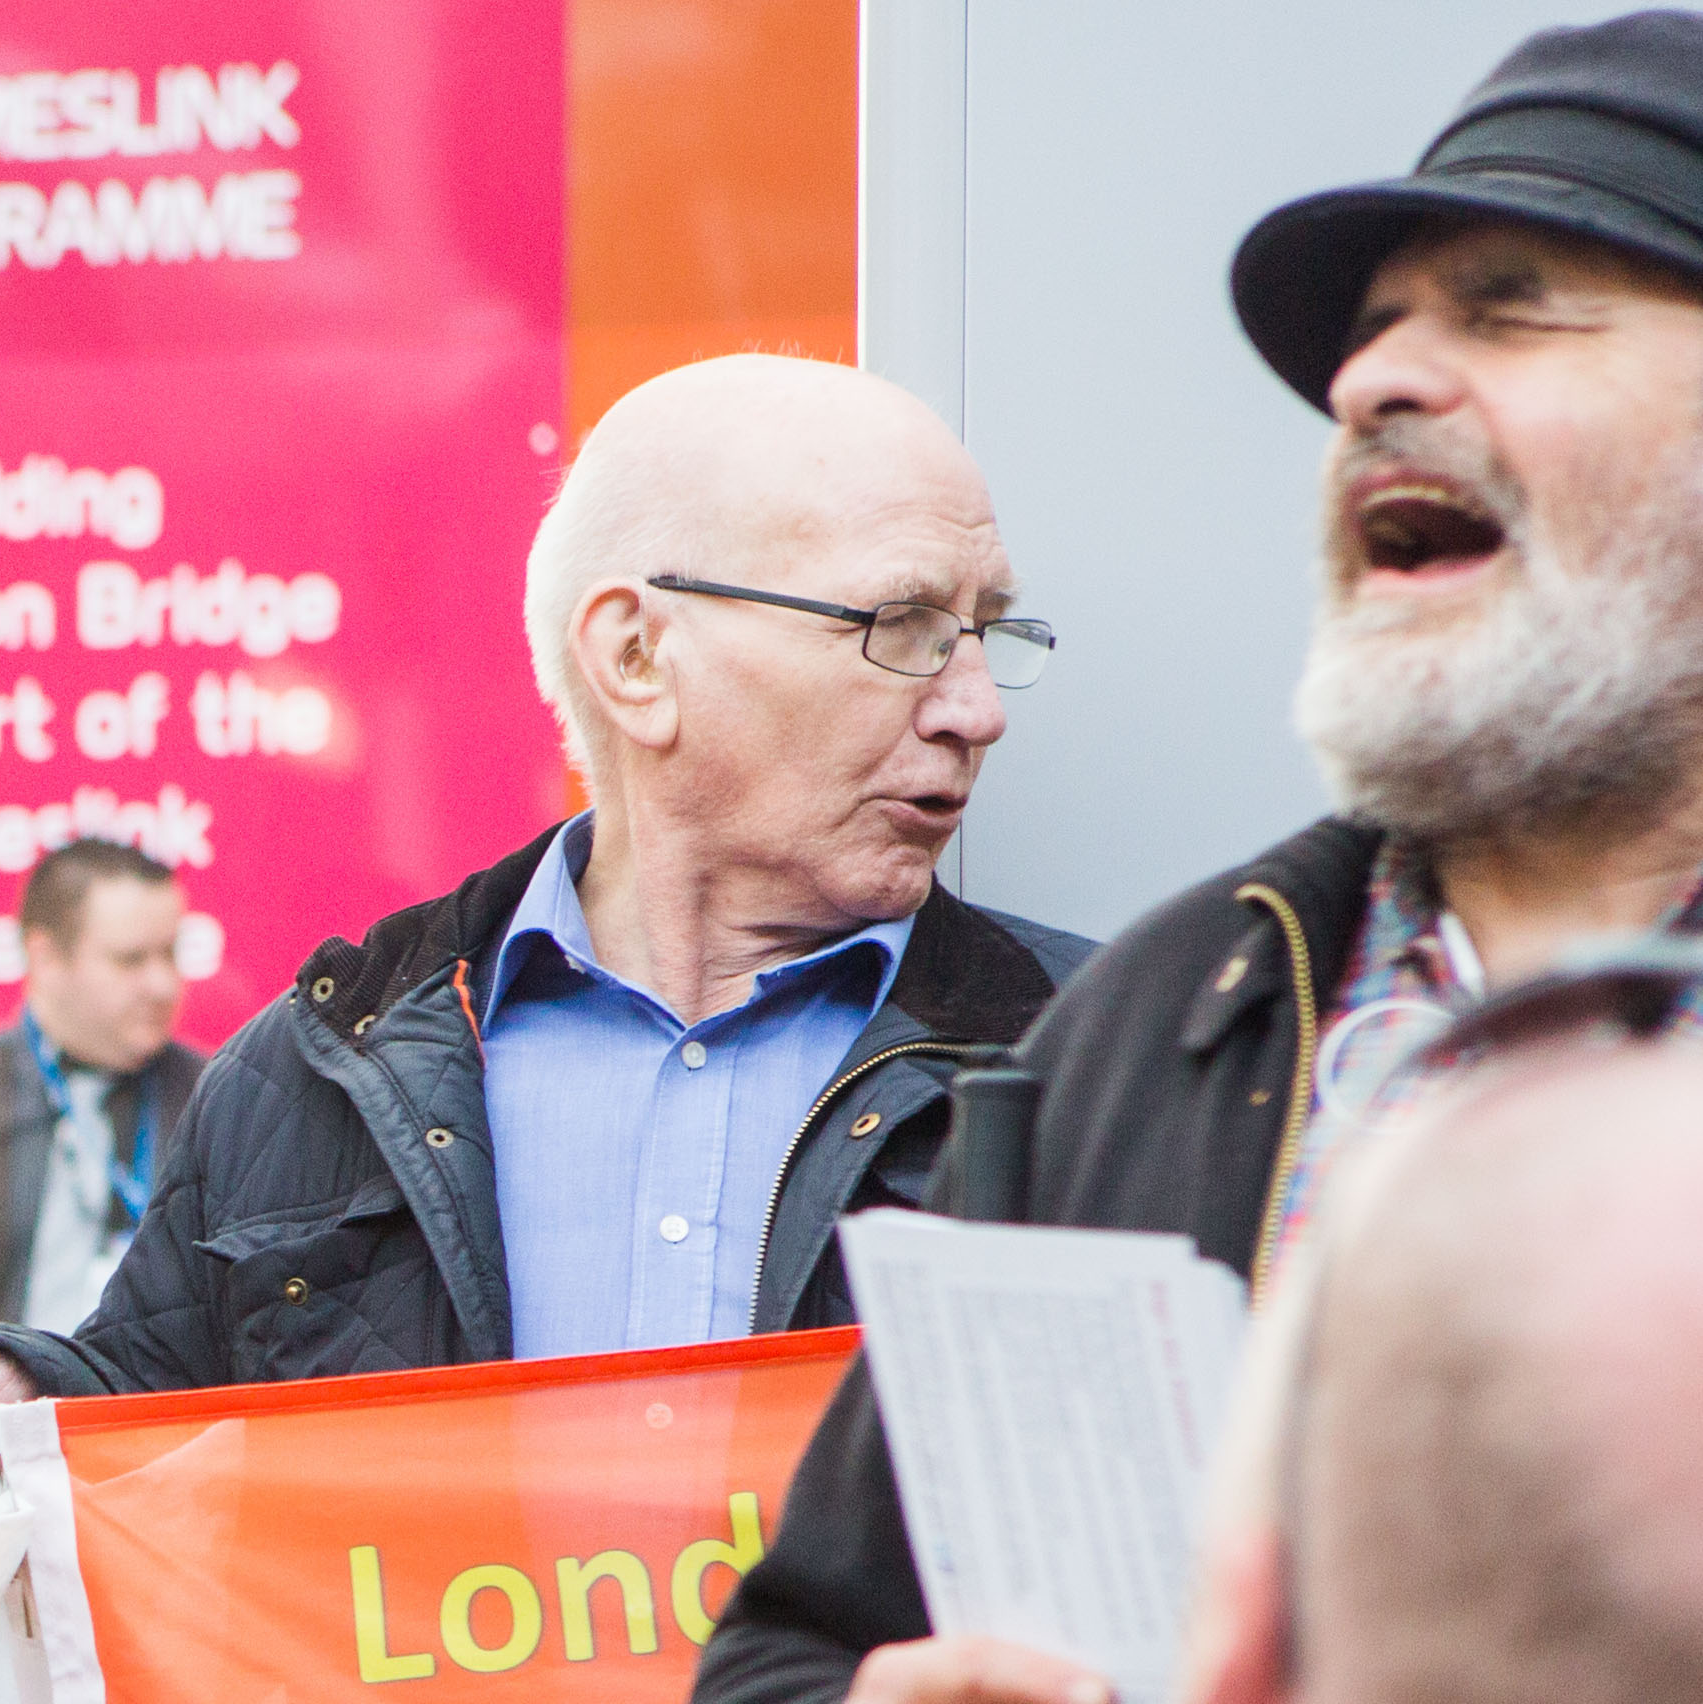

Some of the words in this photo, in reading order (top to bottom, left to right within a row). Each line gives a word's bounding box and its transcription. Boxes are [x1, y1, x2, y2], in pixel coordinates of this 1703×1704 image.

[75, 560, 343, 657] Bridge
[75, 672, 169, 760] of
[192, 672, 333, 758] the
